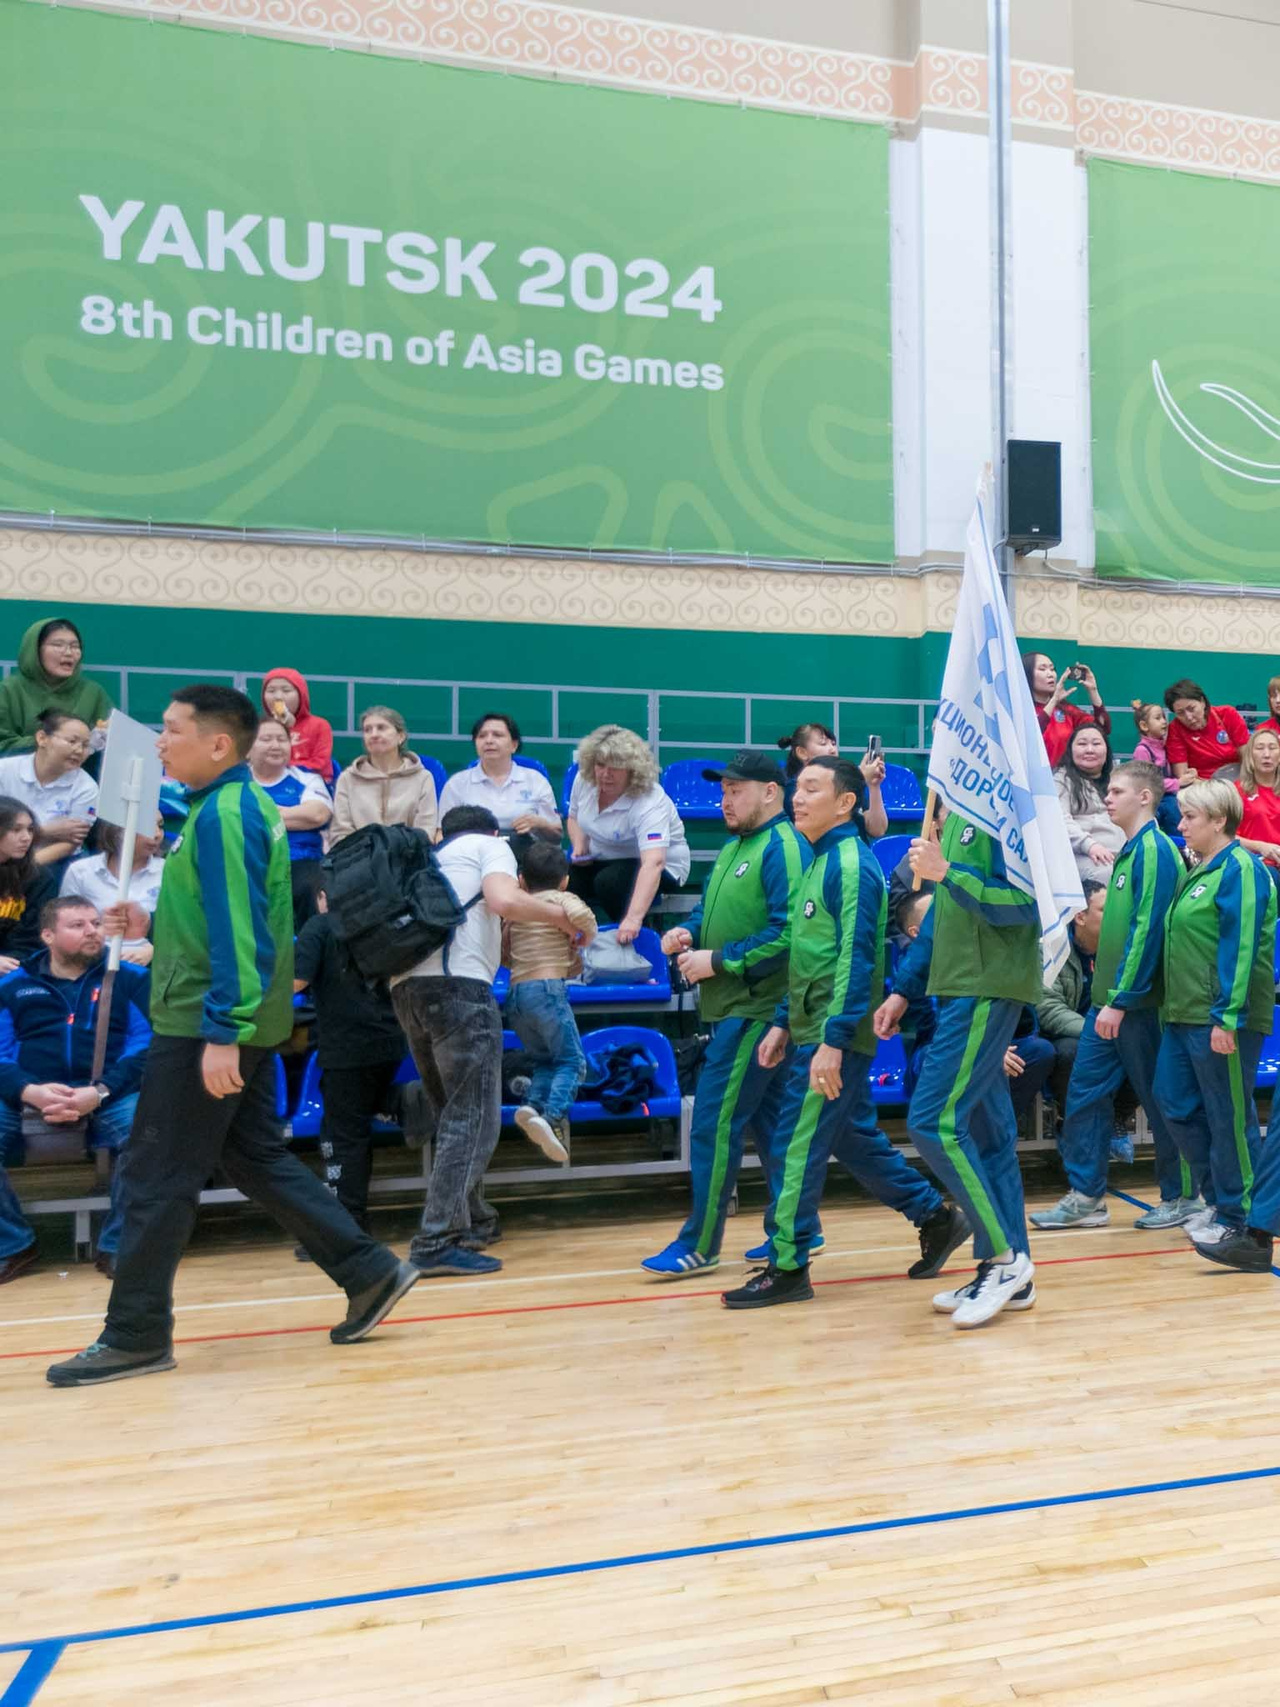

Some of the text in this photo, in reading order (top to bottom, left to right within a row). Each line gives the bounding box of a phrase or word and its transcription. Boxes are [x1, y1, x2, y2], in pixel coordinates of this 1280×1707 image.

[78, 193, 723, 323] YAKUTSK 2024
[80, 293, 725, 391] 8th Children of Asia Games
